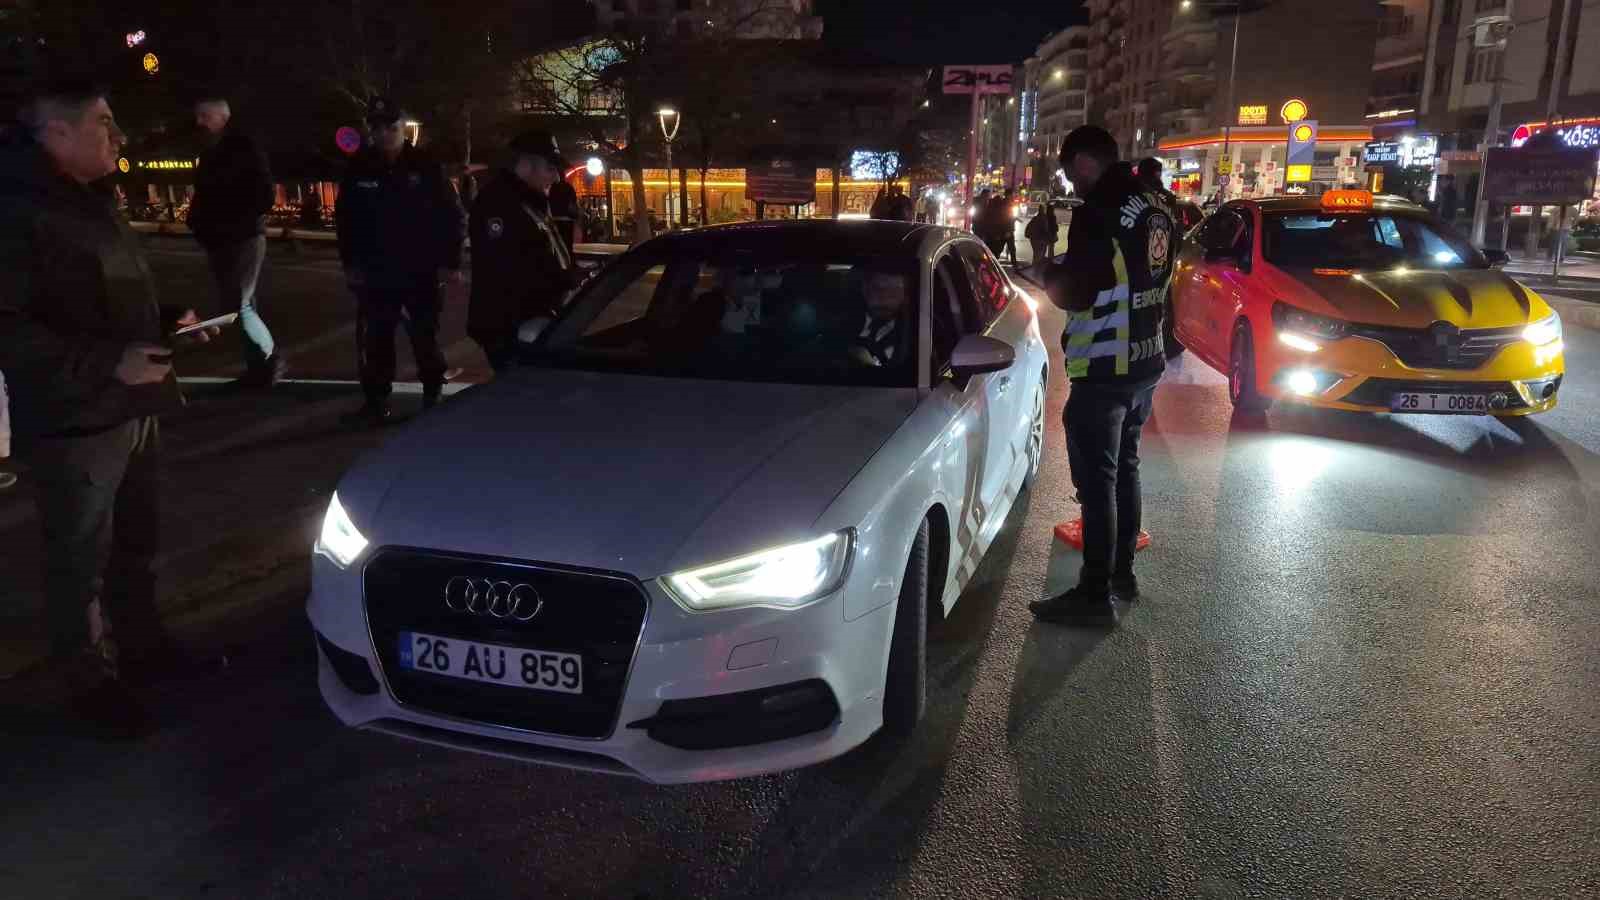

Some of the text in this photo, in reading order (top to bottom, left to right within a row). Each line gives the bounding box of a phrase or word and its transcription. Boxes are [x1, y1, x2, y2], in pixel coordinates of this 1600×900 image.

[1120, 195, 1149, 229] SİVİL
[1401, 395, 1419, 408] 26
[1430, 395, 1439, 408] T
[416, 637, 580, 689] 26 AU 859
